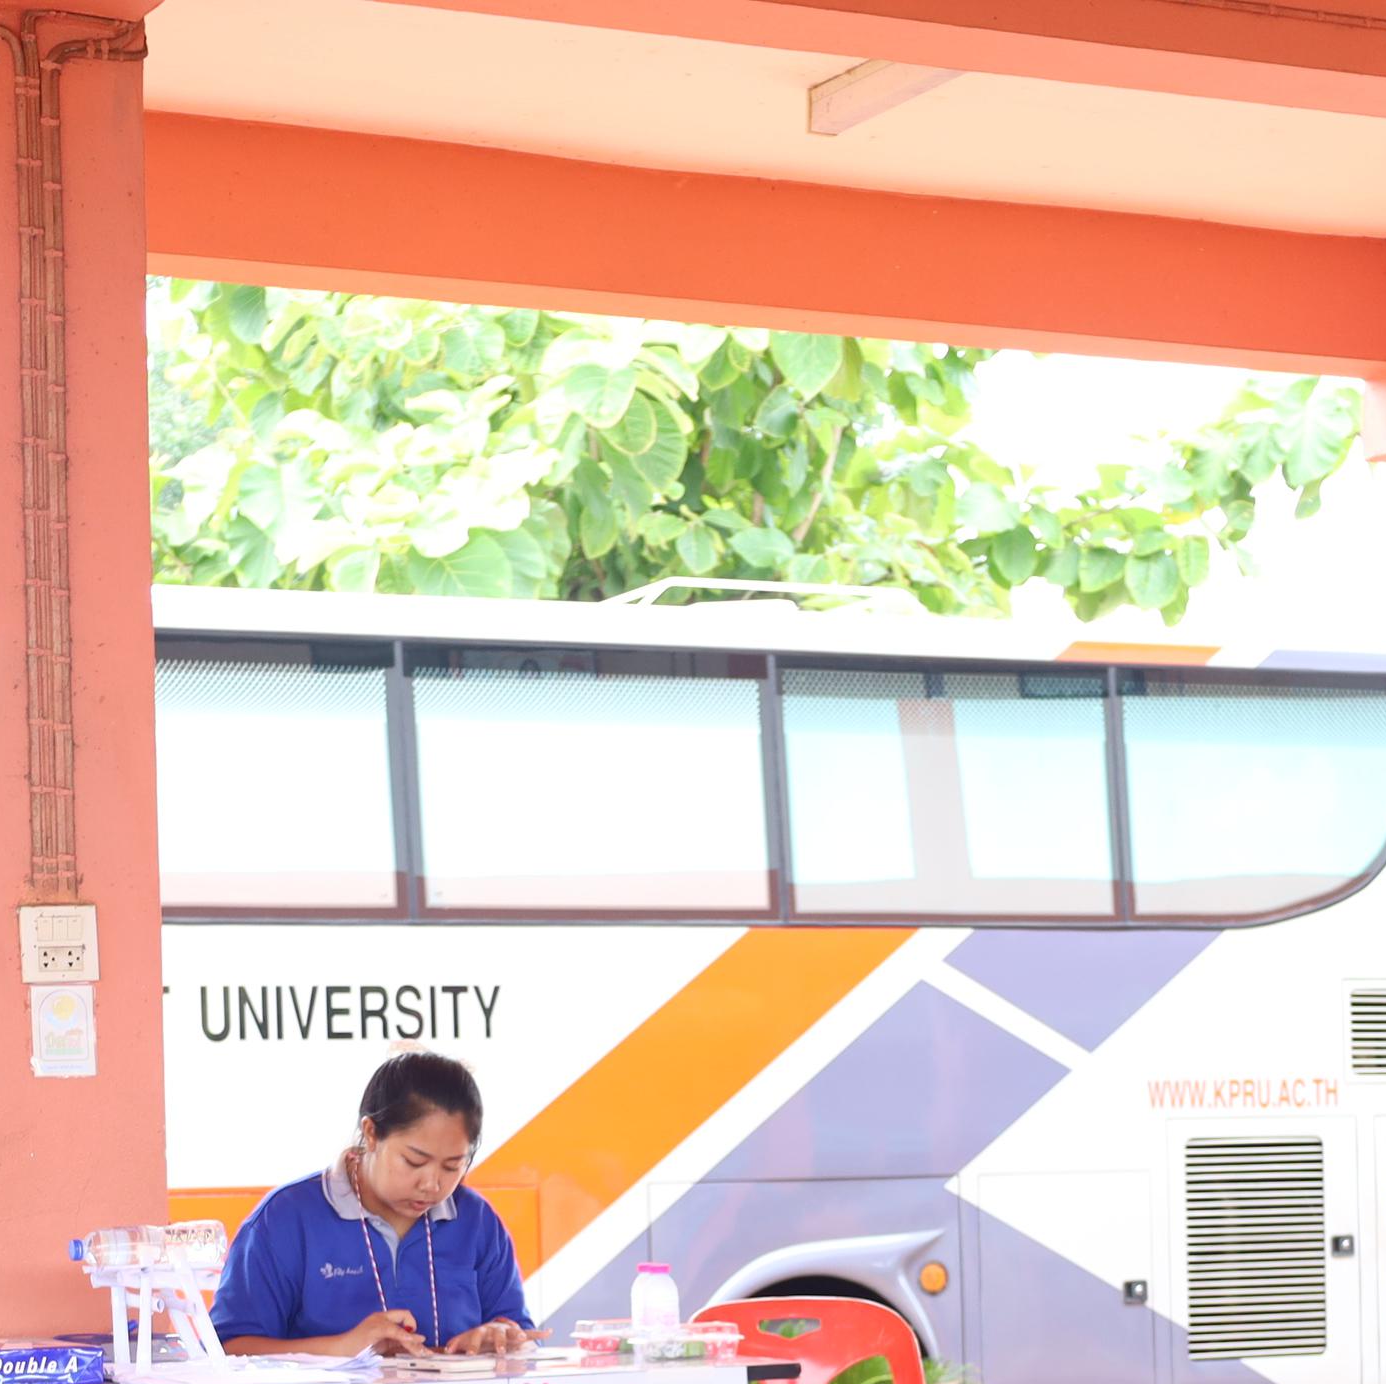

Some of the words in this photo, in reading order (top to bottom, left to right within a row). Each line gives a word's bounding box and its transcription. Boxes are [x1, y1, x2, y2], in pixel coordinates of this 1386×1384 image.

[201, 985, 501, 1042] UNIVERSITY
[1148, 1079, 1338, 1108] WWW.KPRU.AC.TH
[64, 1355, 79, 1374] A
